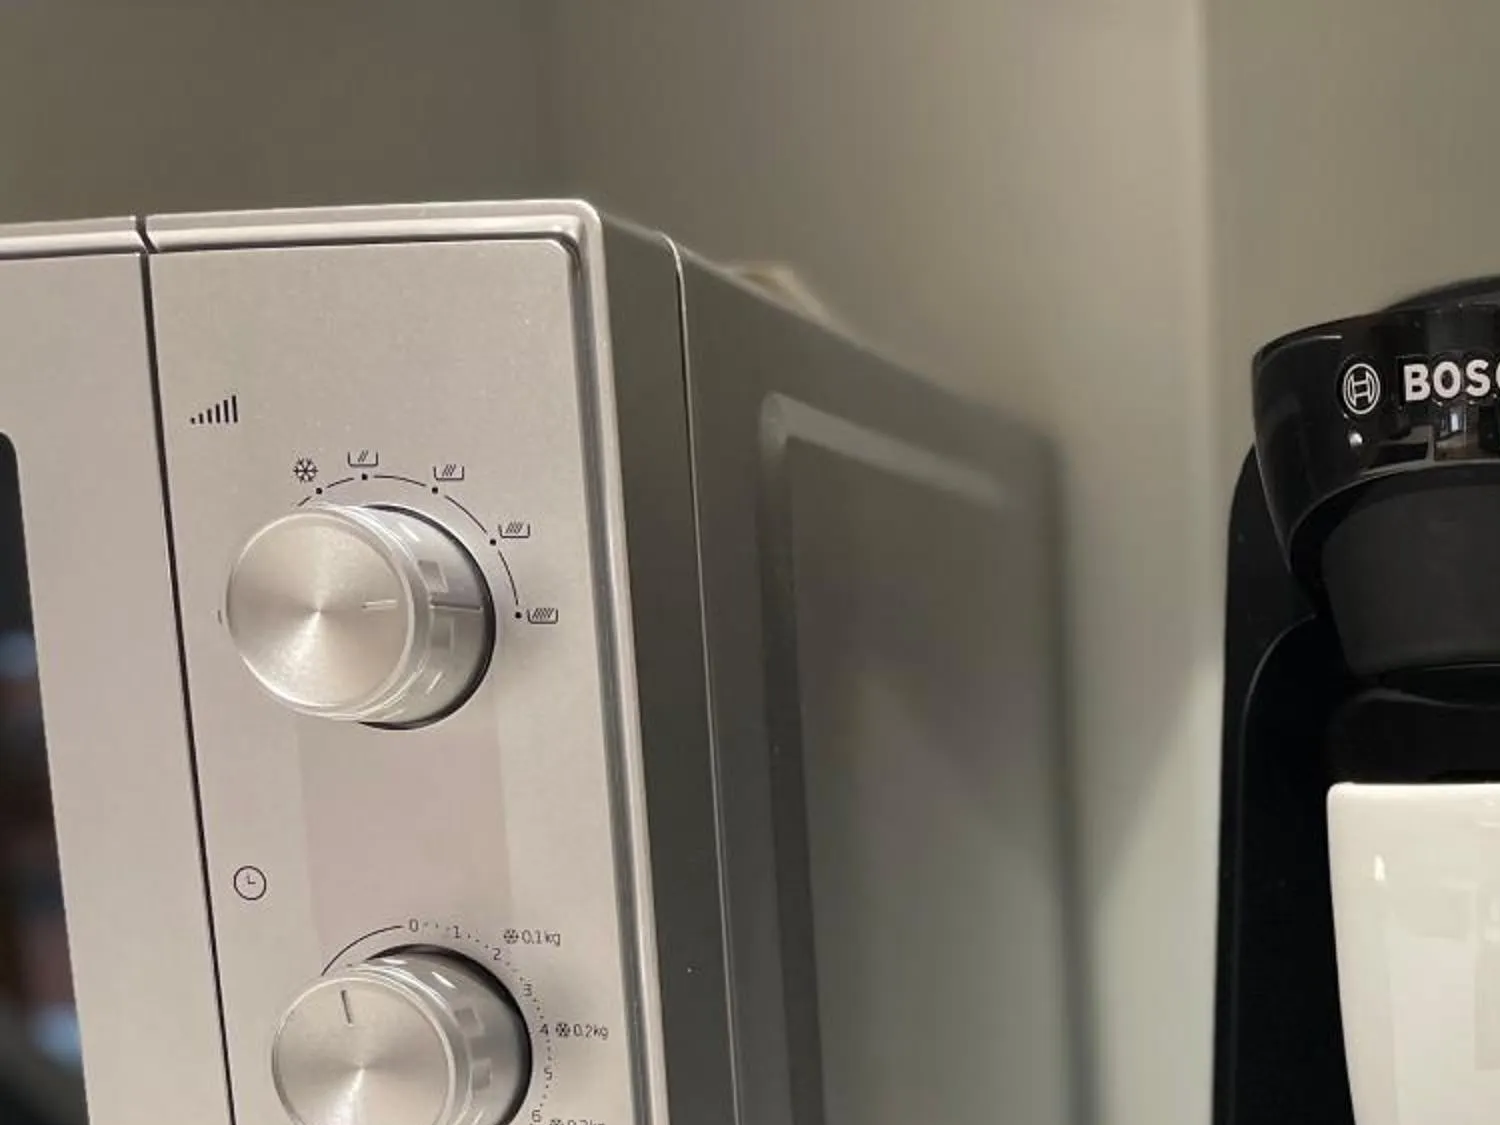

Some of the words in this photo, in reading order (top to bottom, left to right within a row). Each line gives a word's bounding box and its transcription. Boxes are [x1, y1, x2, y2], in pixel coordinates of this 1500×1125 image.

[408, 918, 420, 933] 0
[452, 924, 462, 939] 1
[521, 929, 561, 948] 0.1kg
[491, 947, 502, 961] 2
[540, 1022, 550, 1037] 4
[572, 1023, 610, 1041] 0.2kg
[543, 1066, 554, 1081] 5
[530, 1108, 542, 1124] 6
